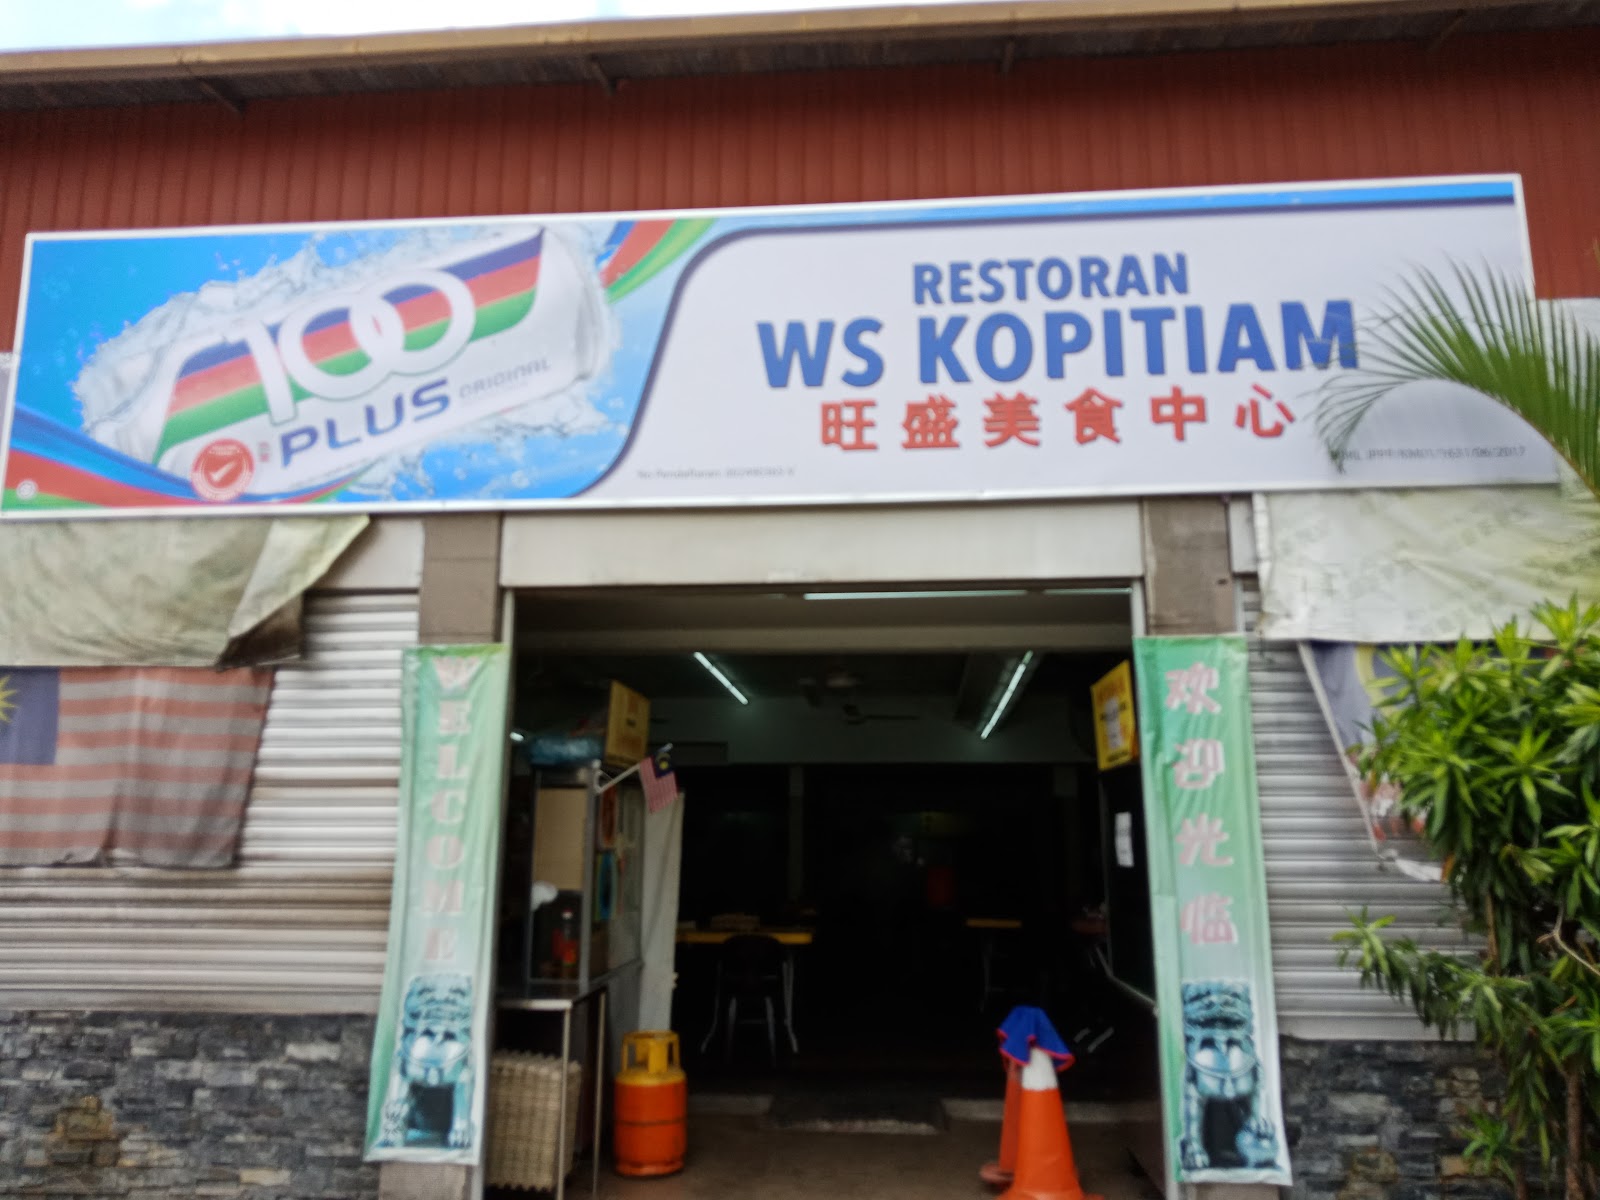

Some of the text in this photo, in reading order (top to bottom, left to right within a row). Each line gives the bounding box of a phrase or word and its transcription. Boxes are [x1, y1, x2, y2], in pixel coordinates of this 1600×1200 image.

[914, 251, 1190, 307] RESTORAN
[224, 268, 477, 427] 100
[757, 299, 1359, 389] WS KOPITIAM
[280, 378, 451, 469] PLUS
[821, 384, 1295, 451] 旺盛美食中心
[421, 655, 482, 961] WELCOME
[1164, 662, 1238, 944] 欢迎光临
